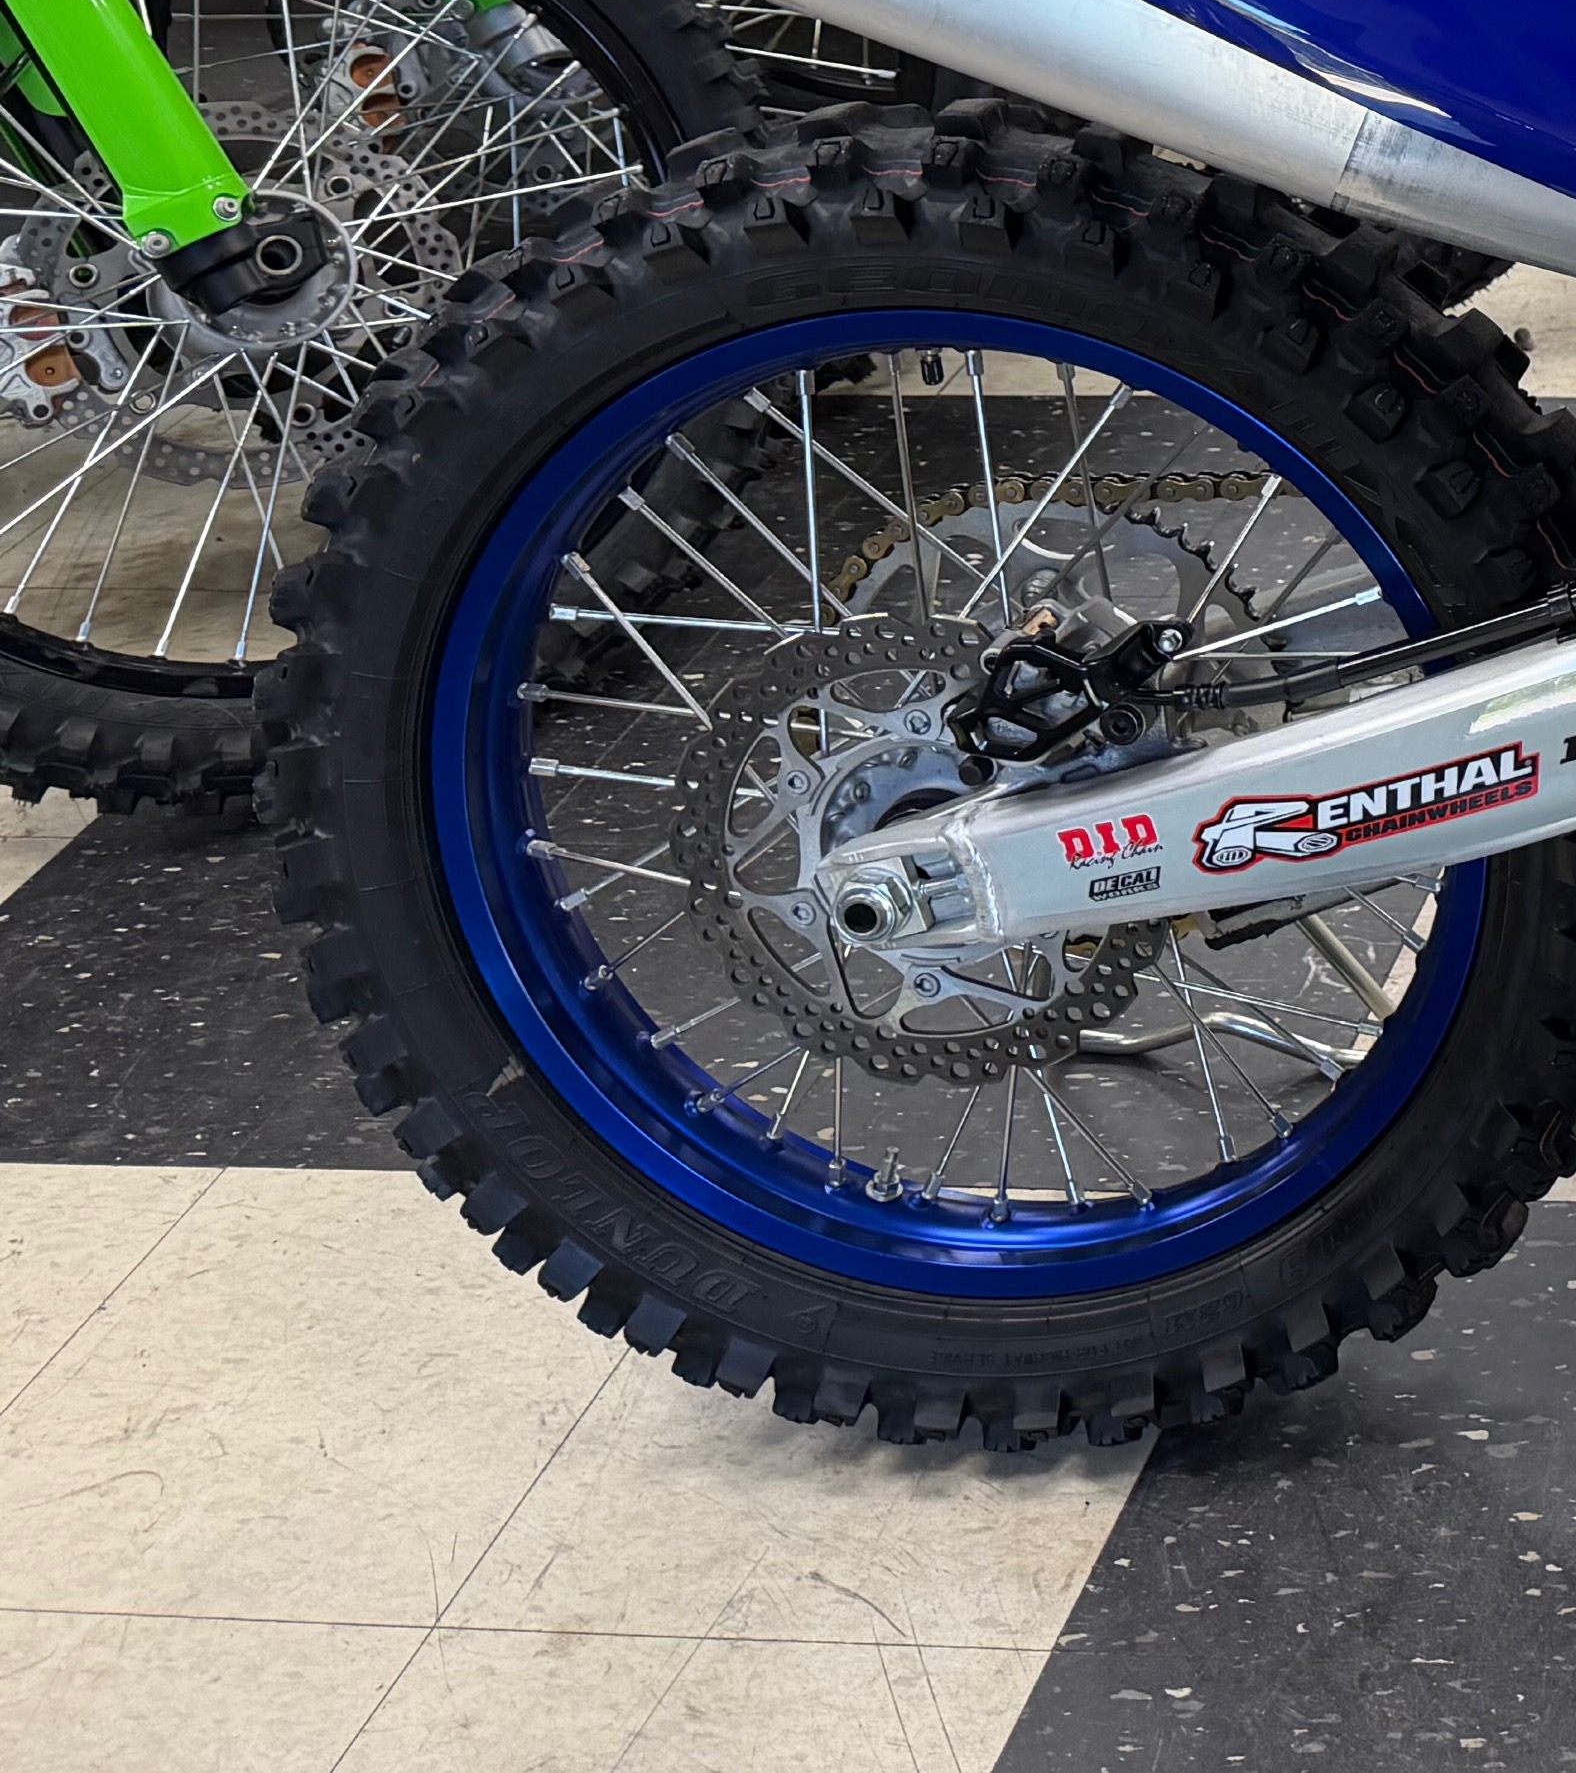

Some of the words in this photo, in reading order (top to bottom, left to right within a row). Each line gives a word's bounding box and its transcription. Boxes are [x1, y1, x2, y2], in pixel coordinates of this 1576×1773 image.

[1345, 780, 1534, 843] CHAINWHEELS
[1069, 850, 1118, 872] Racing
[1120, 837, 1164, 860] Chain
[1091, 881, 1160, 902] WORKS
[1092, 867, 1158, 894] DECAL
[462, 1089, 769, 1316] DUNLOP
